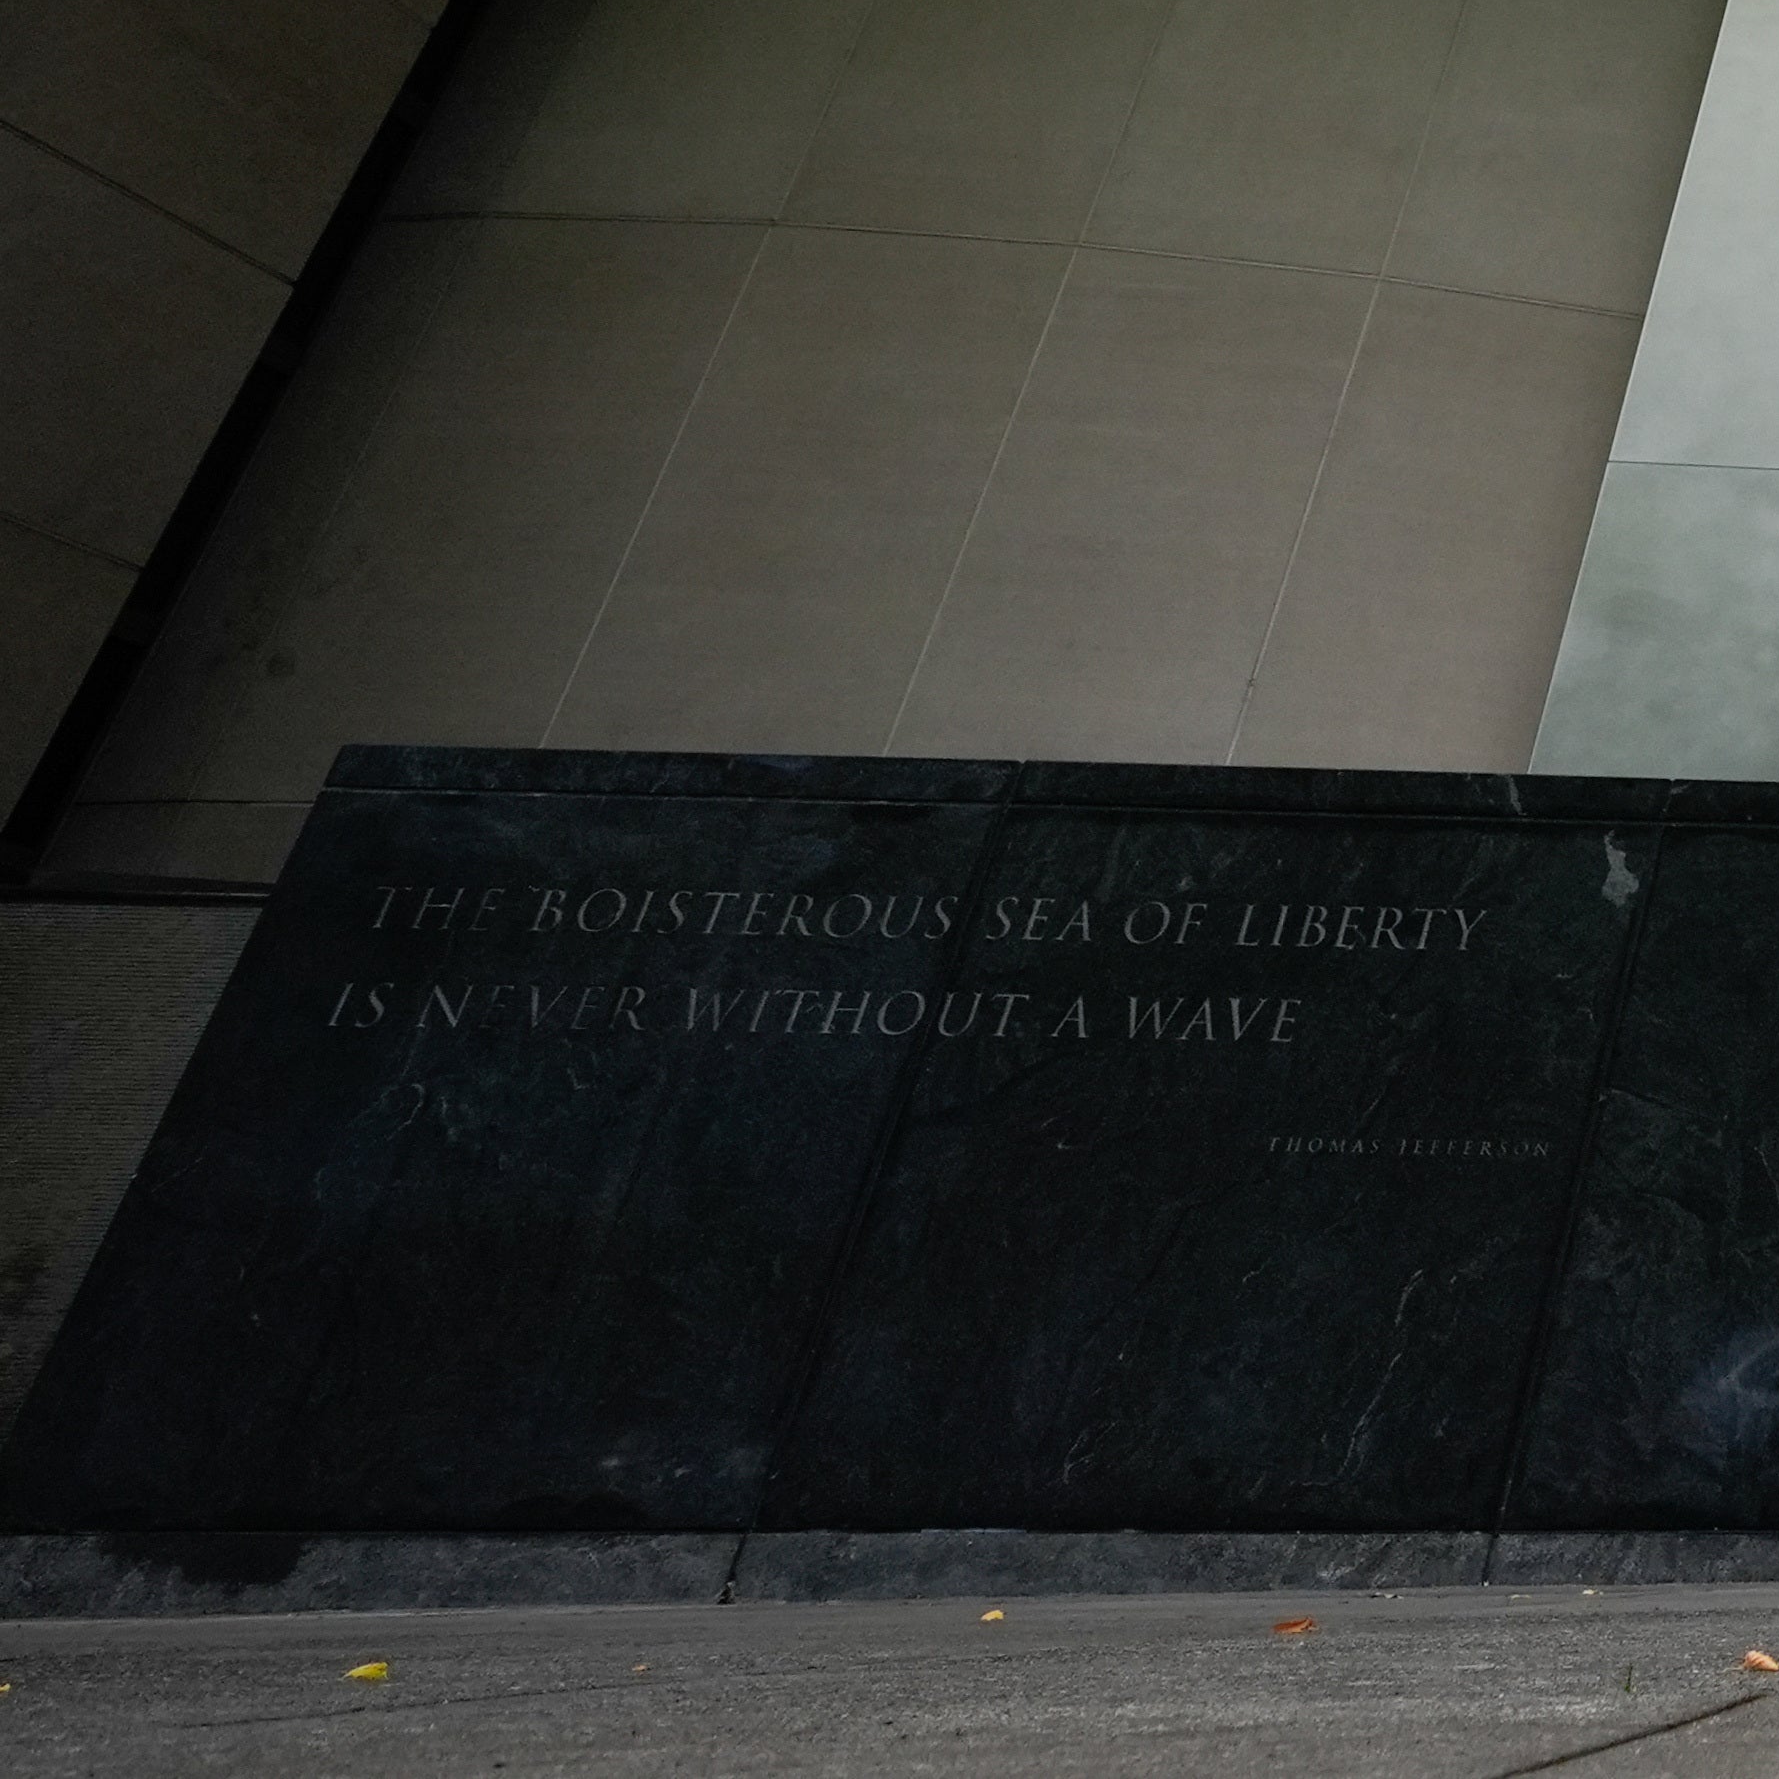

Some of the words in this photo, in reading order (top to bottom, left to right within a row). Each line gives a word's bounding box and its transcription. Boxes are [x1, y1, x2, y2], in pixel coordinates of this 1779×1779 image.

[371, 884, 505, 932] THE
[528, 884, 960, 940] BOISTEROUS
[985, 895, 1093, 943] SEA
[1122, 901, 1209, 946] OF
[1234, 902, 1488, 951] LIBERTY
[327, 981, 395, 1029] IS
[415, 982, 646, 1032] NEVER
[685, 988, 1030, 1038] WITHOUT
[1051, 995, 1090, 1039] A
[1127, 996, 1302, 1044] WAVE
[1268, 1136, 1381, 1154] THOMAS
